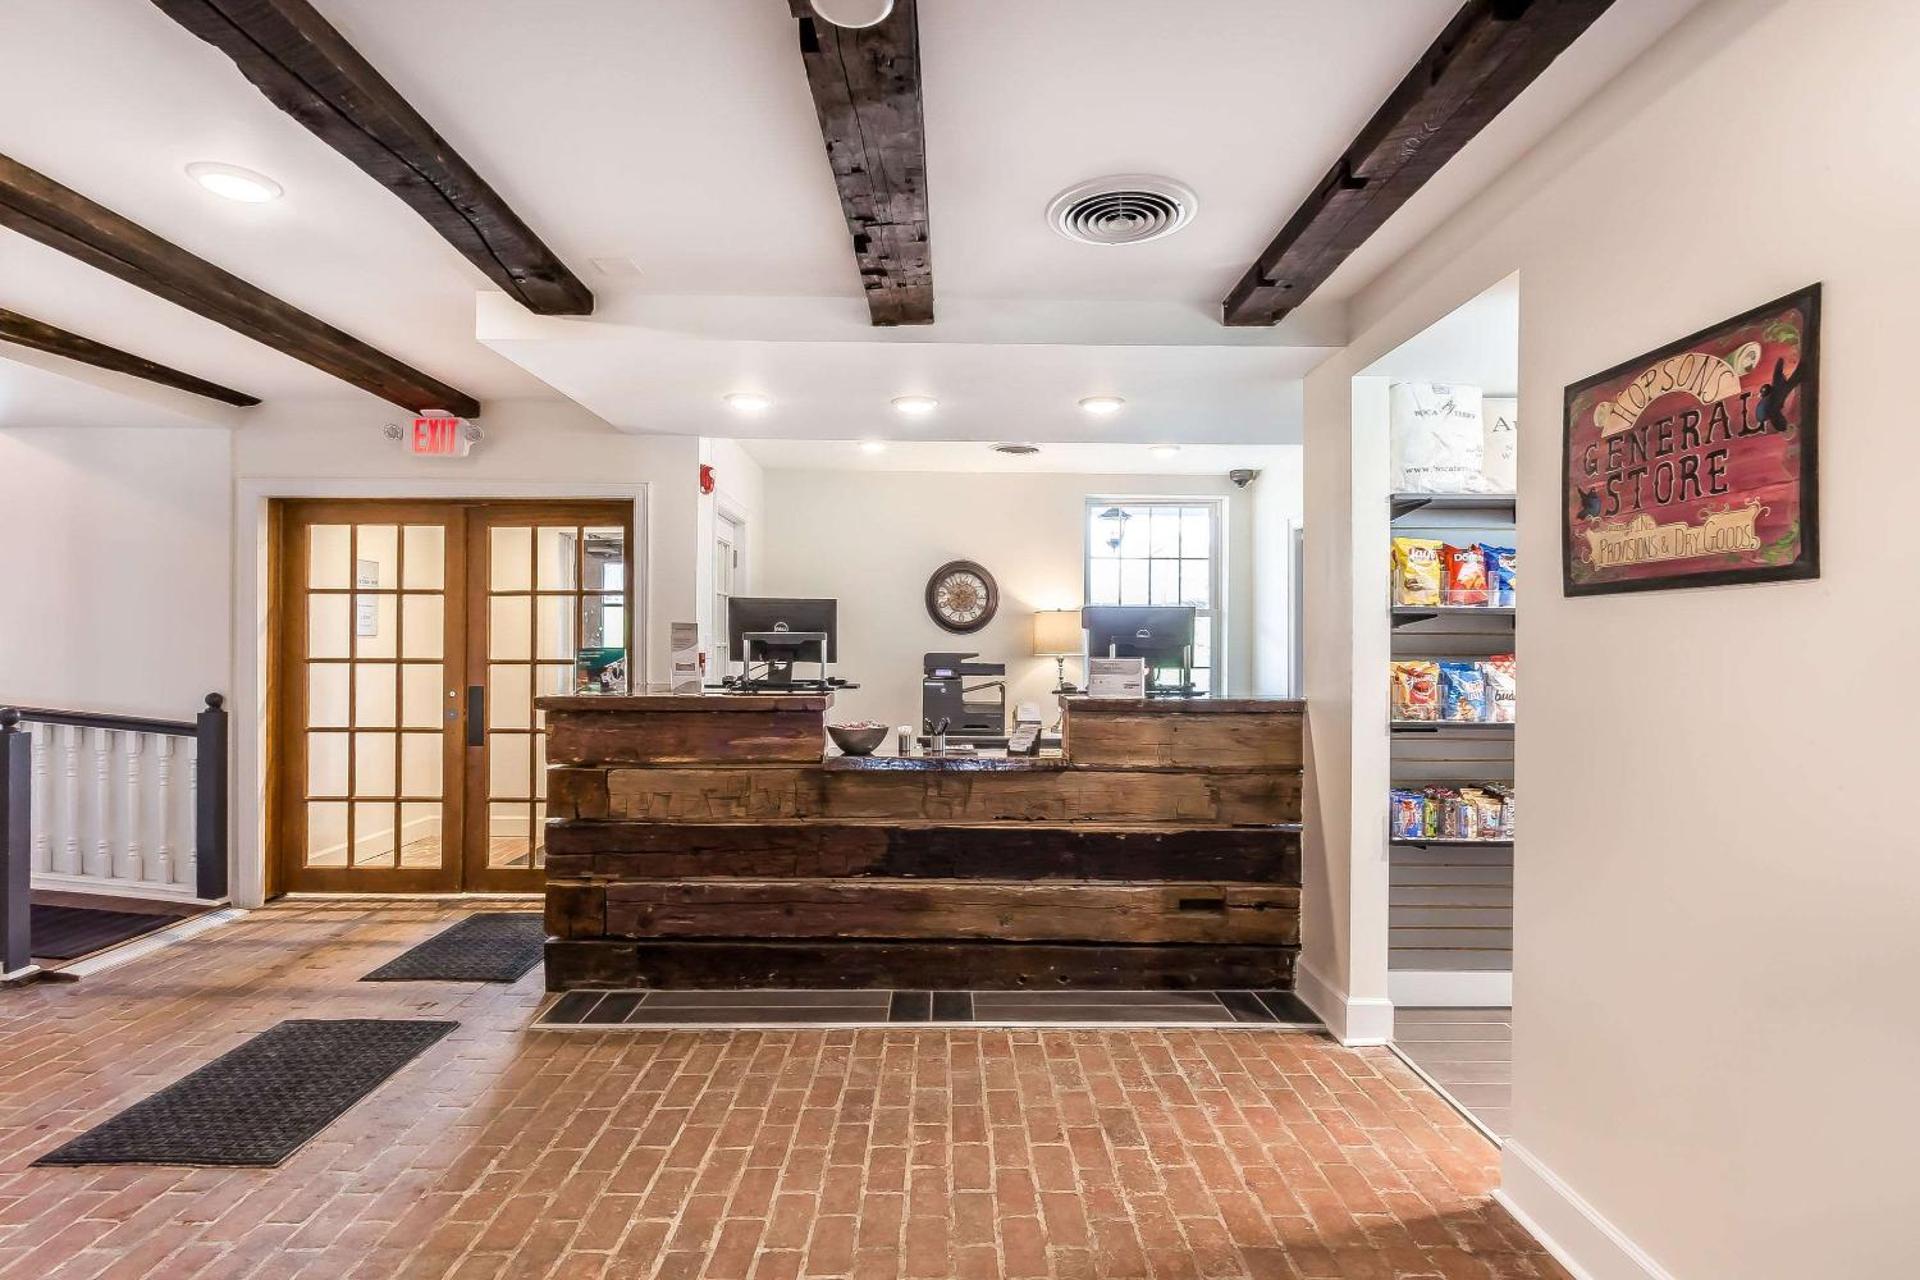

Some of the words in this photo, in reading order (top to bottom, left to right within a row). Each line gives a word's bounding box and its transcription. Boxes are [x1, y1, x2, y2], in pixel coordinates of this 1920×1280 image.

[413, 418, 458, 453] EXIT
[1584, 391, 1767, 477] GENERAL
[1605, 448, 1729, 516] STORE
[1661, 536, 1669, 554] &
[1674, 528, 1701, 556] DRY
[1703, 521, 1751, 553] GOODS
